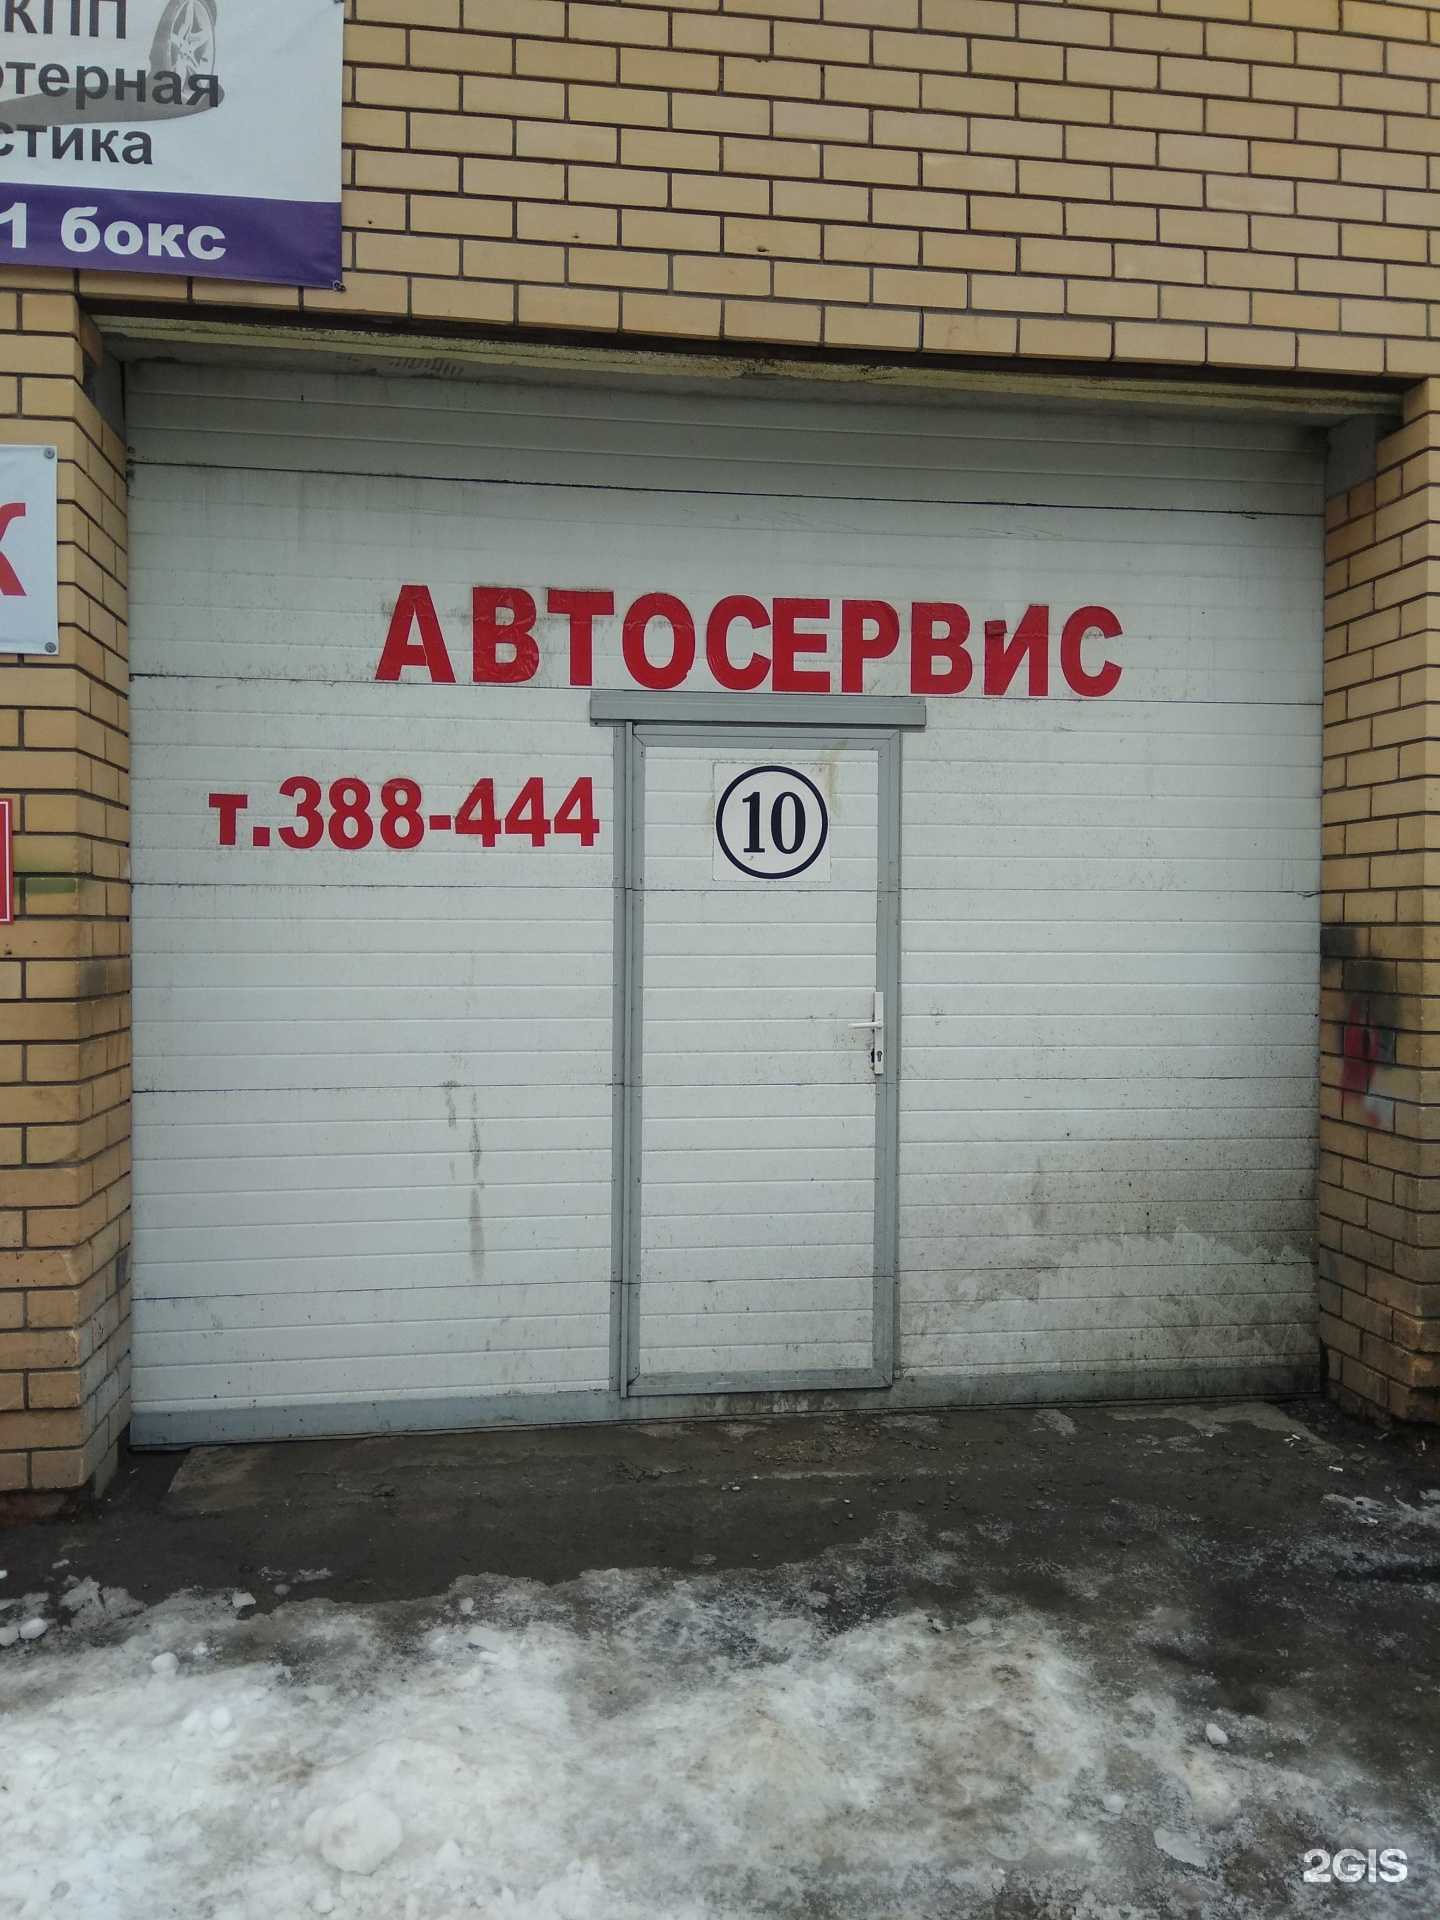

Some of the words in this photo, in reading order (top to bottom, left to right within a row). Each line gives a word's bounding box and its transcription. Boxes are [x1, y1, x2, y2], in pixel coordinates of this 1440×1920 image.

[0, 61, 219, 110] терная
[60, 206, 227, 261] бокс
[374, 584, 1124, 698] АВТОСЕРВИС
[741, 790, 807, 855] 10
